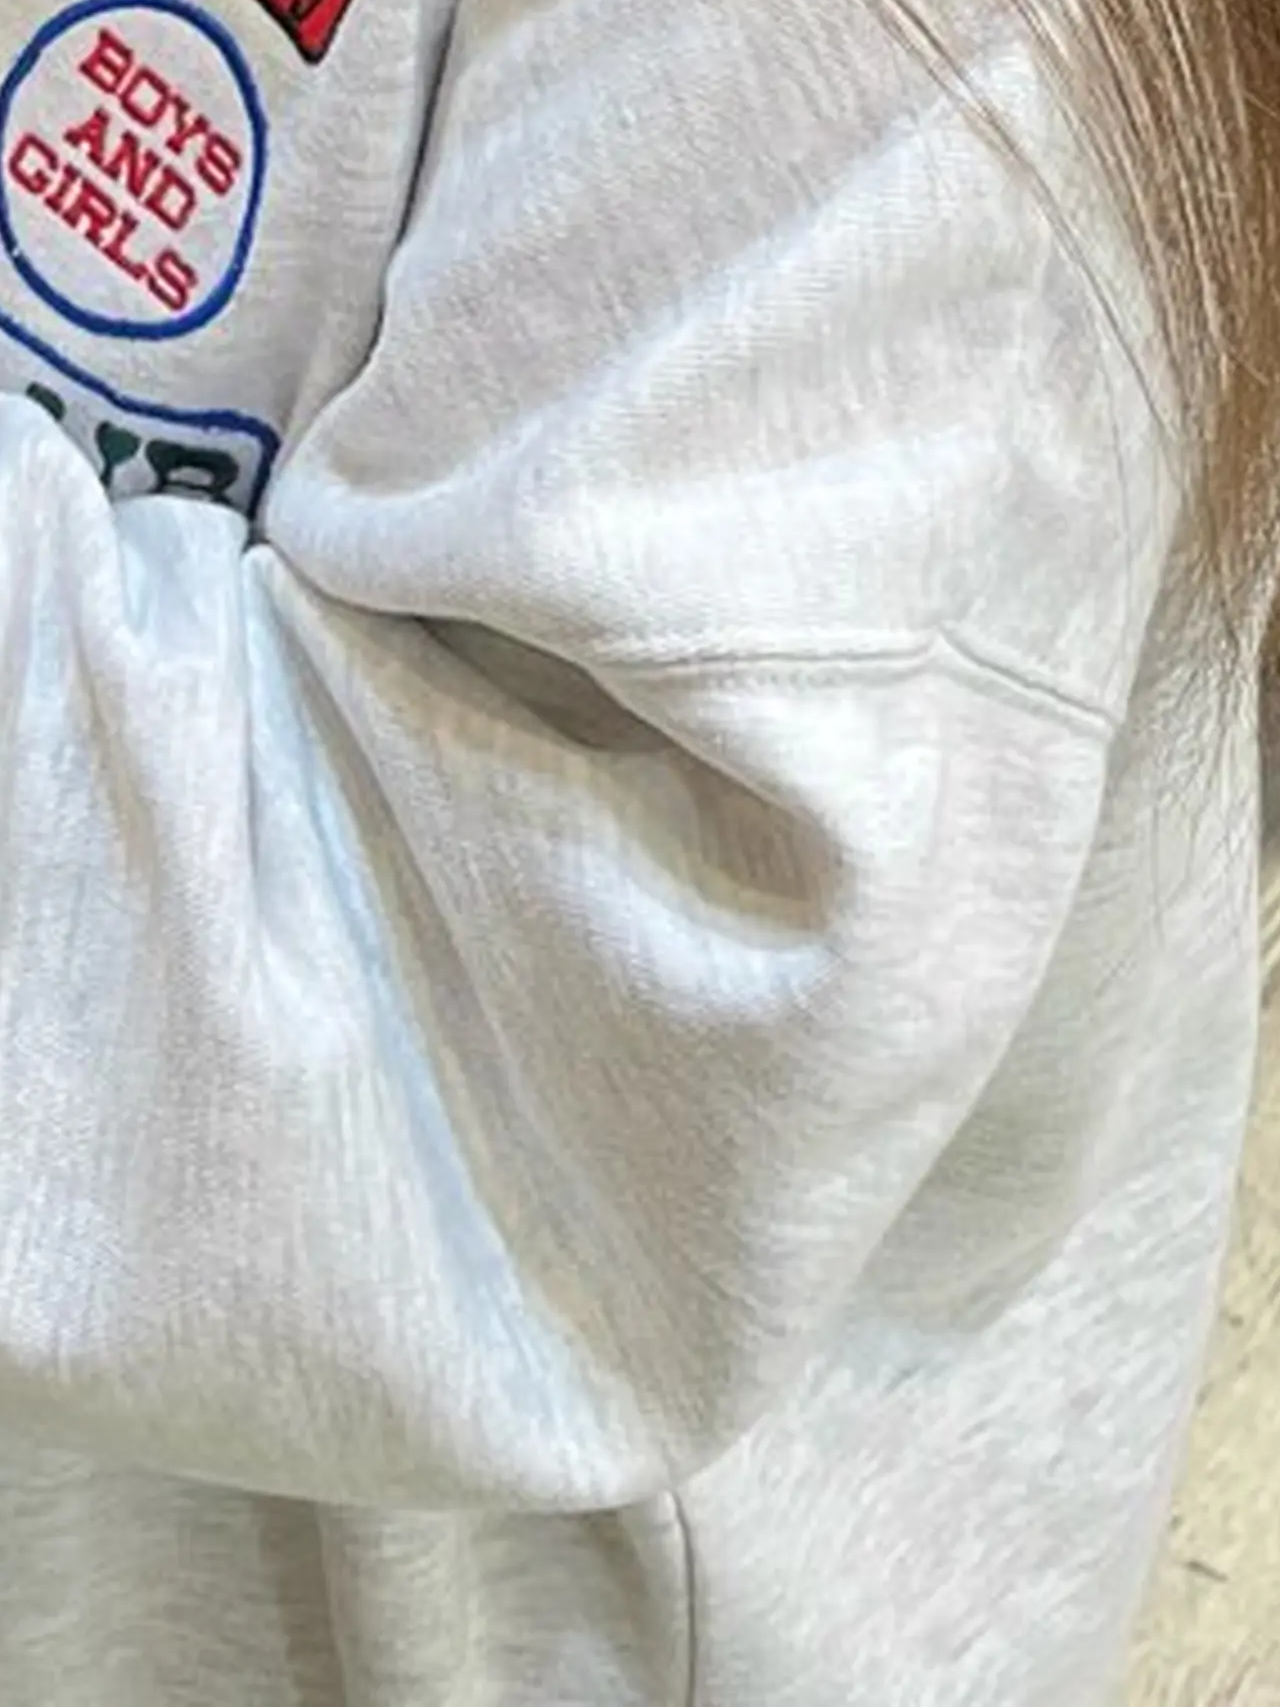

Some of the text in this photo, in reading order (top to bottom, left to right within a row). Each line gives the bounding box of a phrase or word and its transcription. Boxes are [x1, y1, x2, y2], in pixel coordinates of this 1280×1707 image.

[63, 107, 198, 231] AND
[78, 28, 242, 197] BOYS
[8, 133, 199, 311] GIRLS
